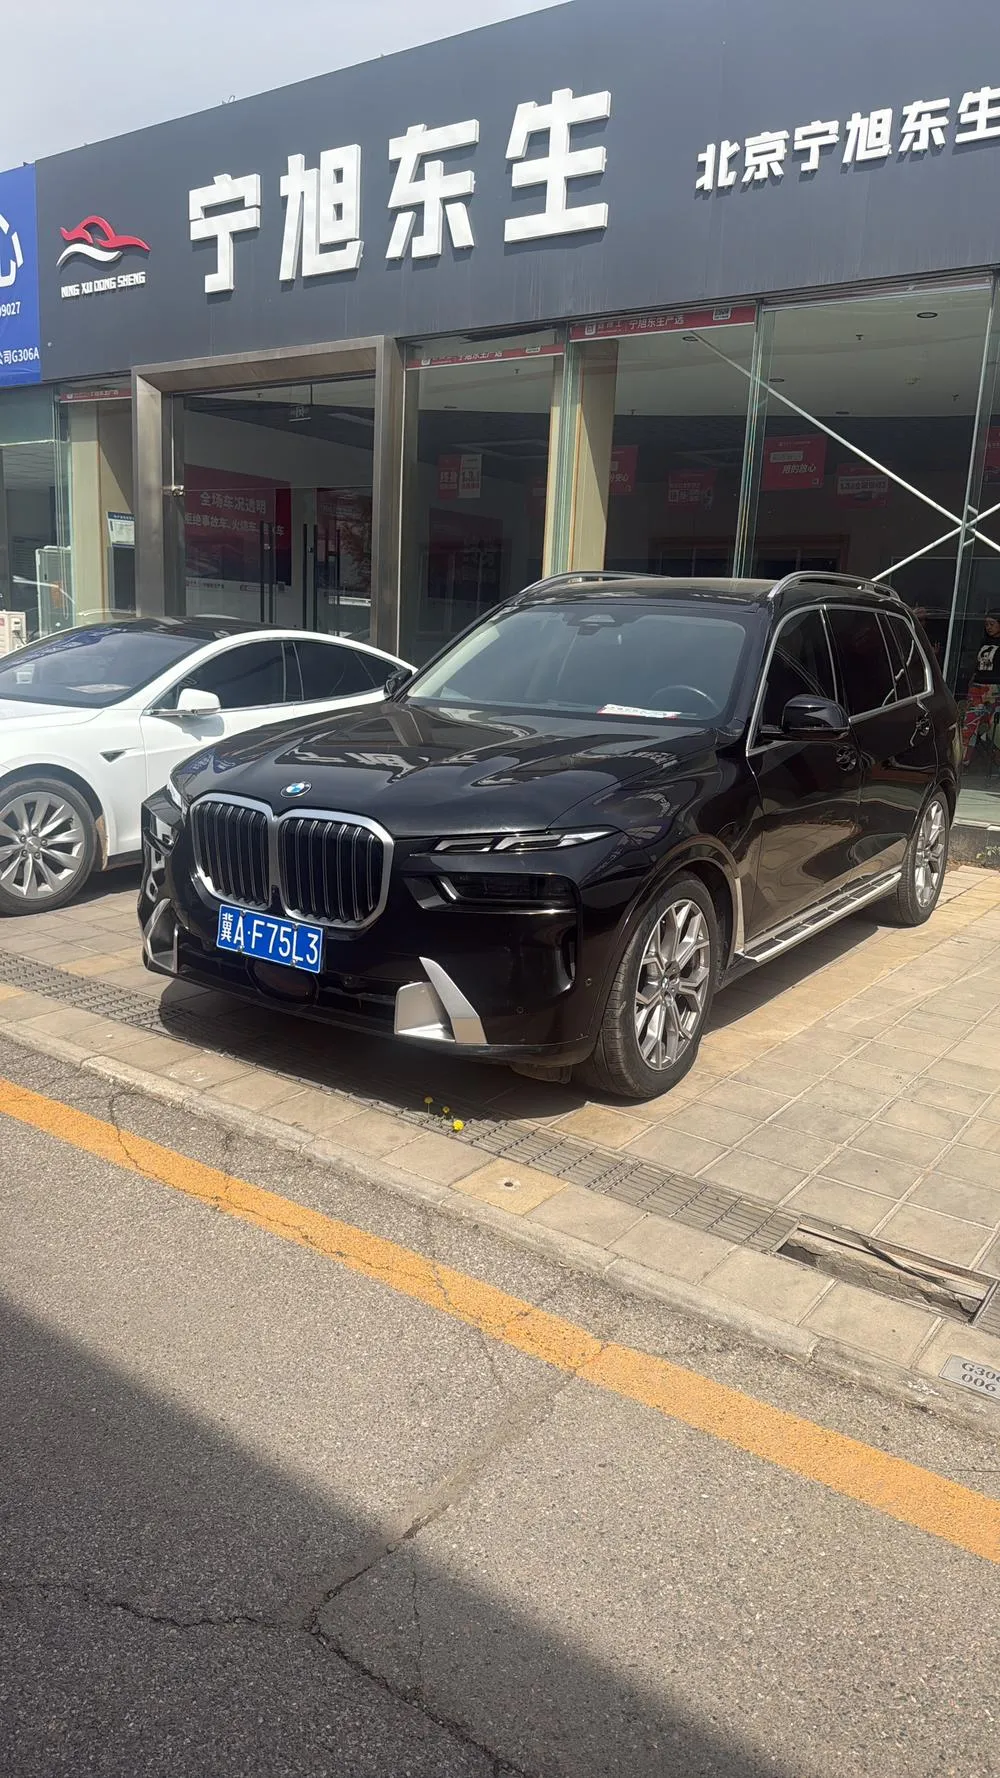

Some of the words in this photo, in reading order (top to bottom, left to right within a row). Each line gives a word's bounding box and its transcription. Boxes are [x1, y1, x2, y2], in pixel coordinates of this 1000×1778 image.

[695, 87, 1000, 192] 北京宁旭东生
[189, 88, 611, 293] 宁旭东生
[61, 284, 80, 298] NING
[81, 281, 93, 294] XU
[94, 277, 116, 292] DONG
[117, 271, 146, 288] SHENG
[200, 491, 266, 514] 全场车况透明
[961, 1373, 996, 1392] 006
